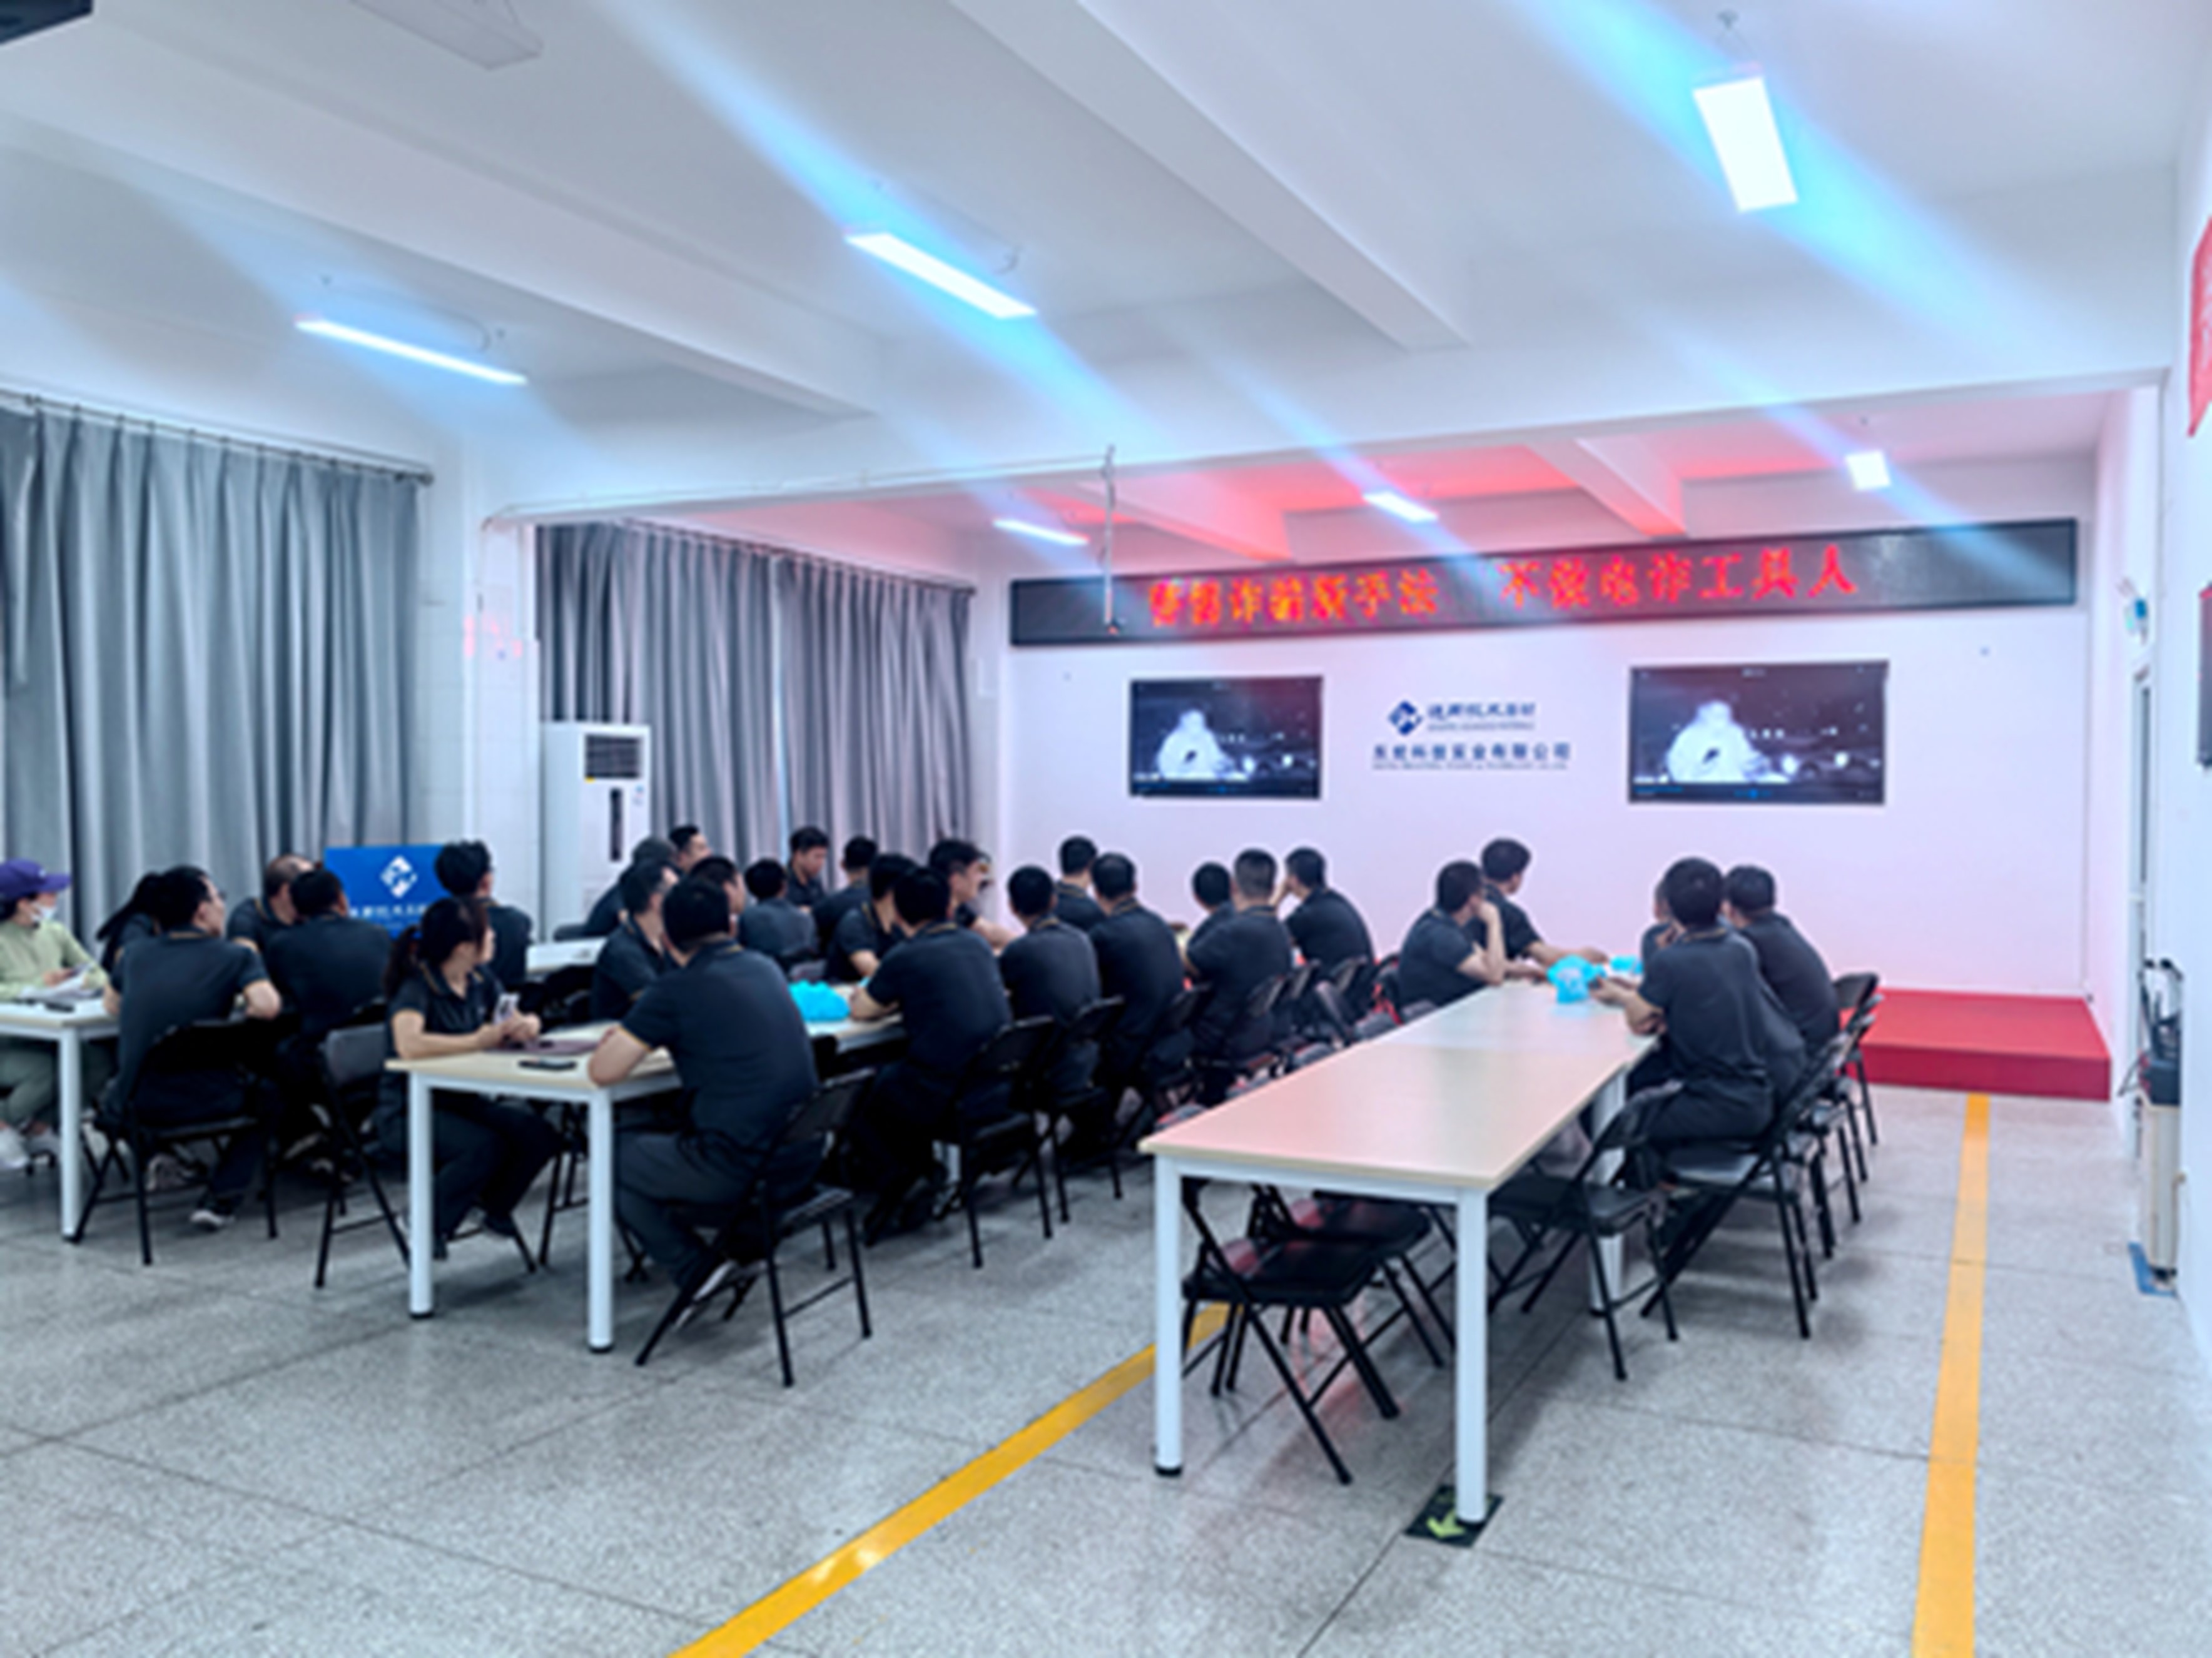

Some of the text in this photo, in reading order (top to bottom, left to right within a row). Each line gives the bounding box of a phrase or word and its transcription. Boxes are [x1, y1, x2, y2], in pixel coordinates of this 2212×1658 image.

[1498, 543, 1858, 610] 不做电诈工具人
